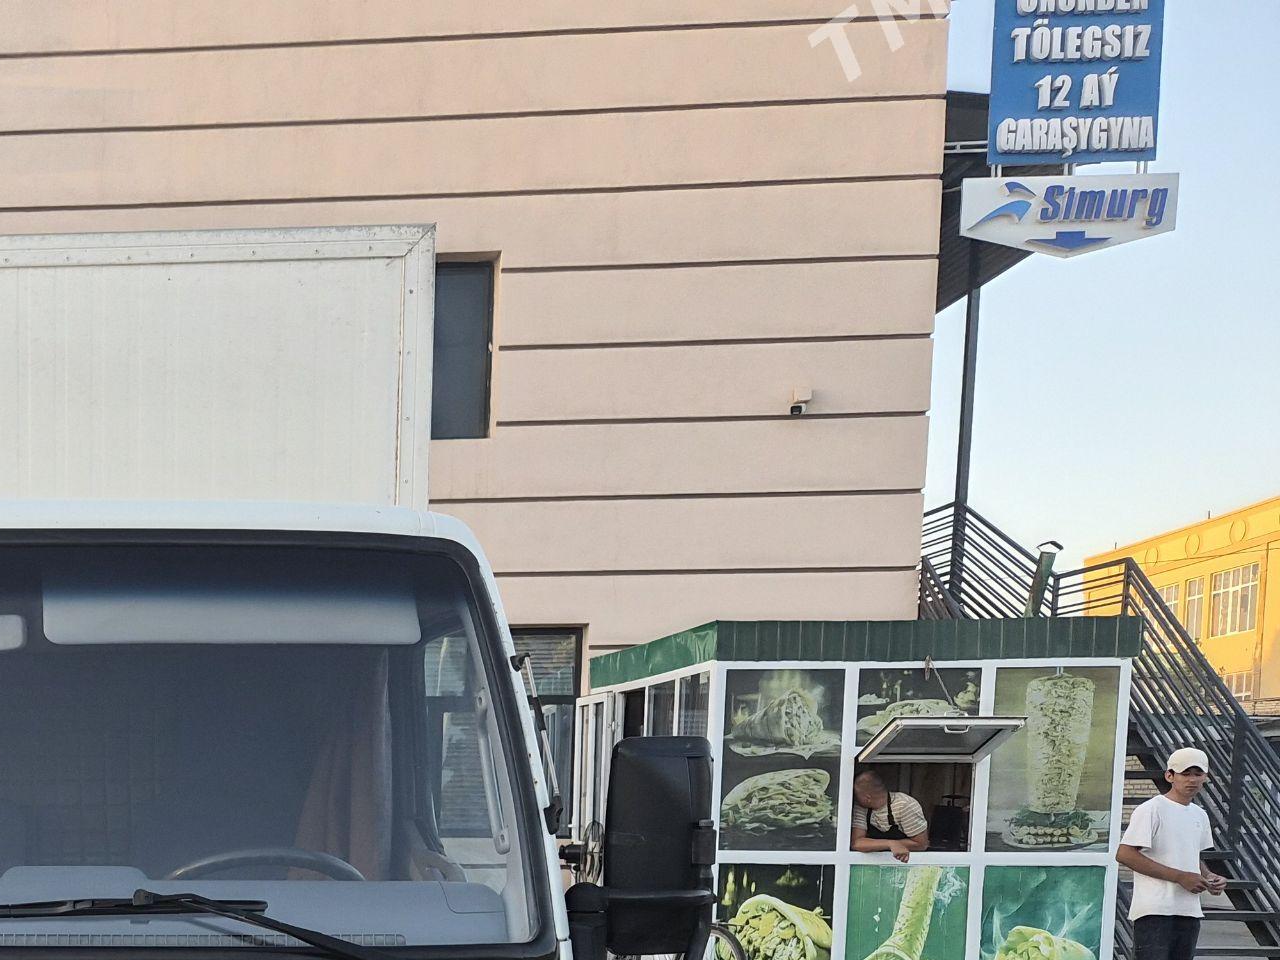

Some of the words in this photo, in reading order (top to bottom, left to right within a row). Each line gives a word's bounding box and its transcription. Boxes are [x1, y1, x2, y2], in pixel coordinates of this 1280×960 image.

[1011, 19, 1152, 62] TÖLEGSIZ
[1035, 75, 1072, 109] 12
[1080, 66, 1120, 108] AÝ
[996, 116, 1155, 158] GARAŞYGYNA
[1039, 185, 1169, 227] Simurg
